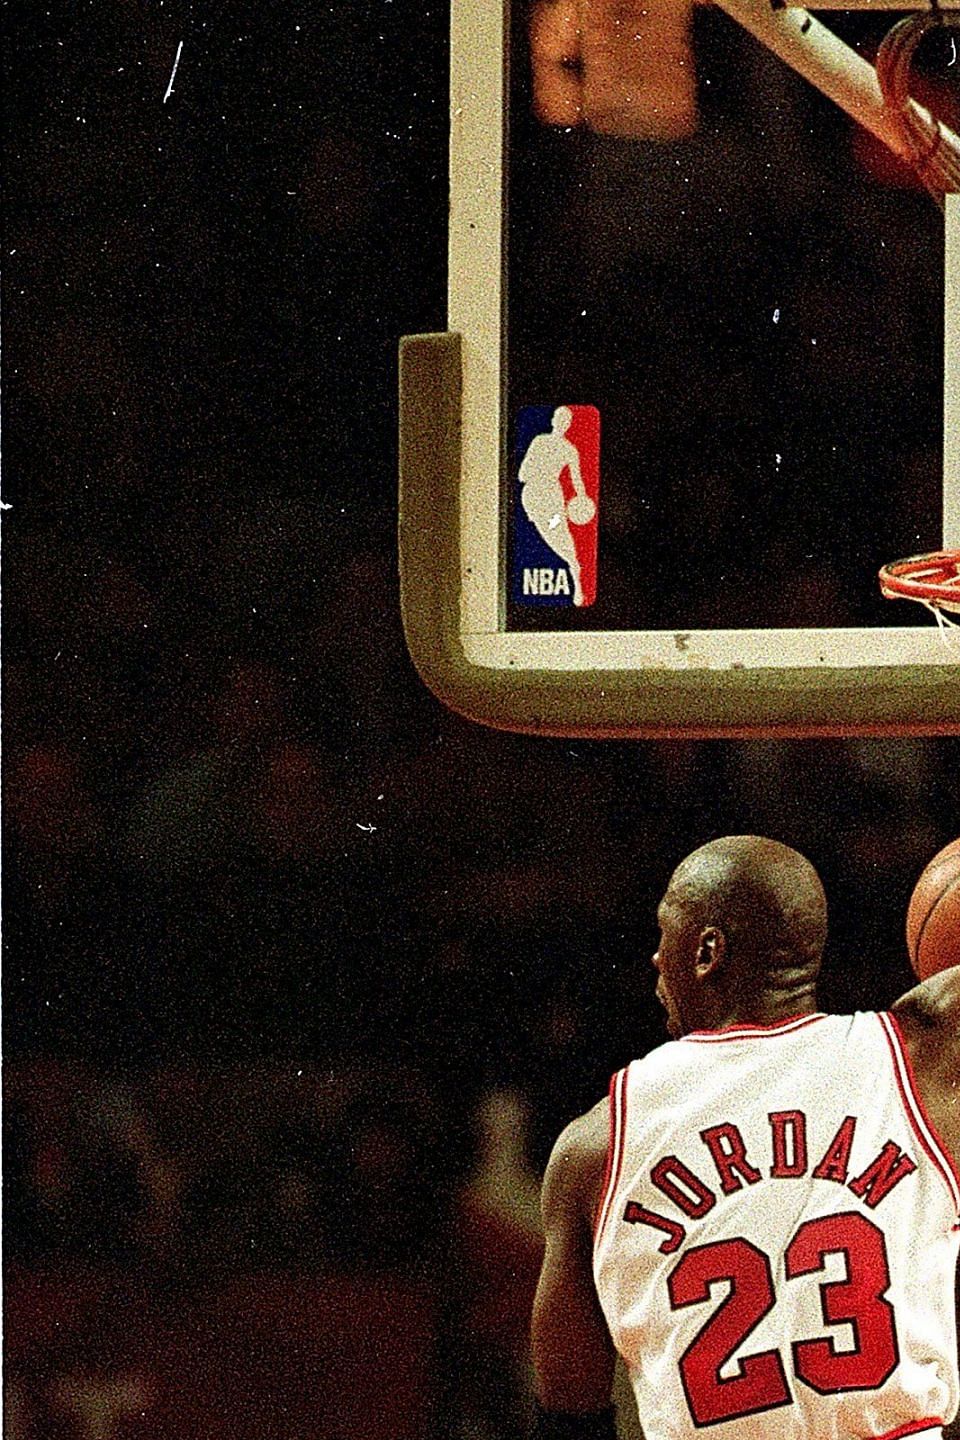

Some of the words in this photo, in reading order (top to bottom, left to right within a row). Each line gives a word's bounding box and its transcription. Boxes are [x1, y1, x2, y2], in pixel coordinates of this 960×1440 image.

[523, 568, 571, 595] NBA
[622, 1109, 918, 1256] JORDAN
[666, 1210, 900, 1429] 23
